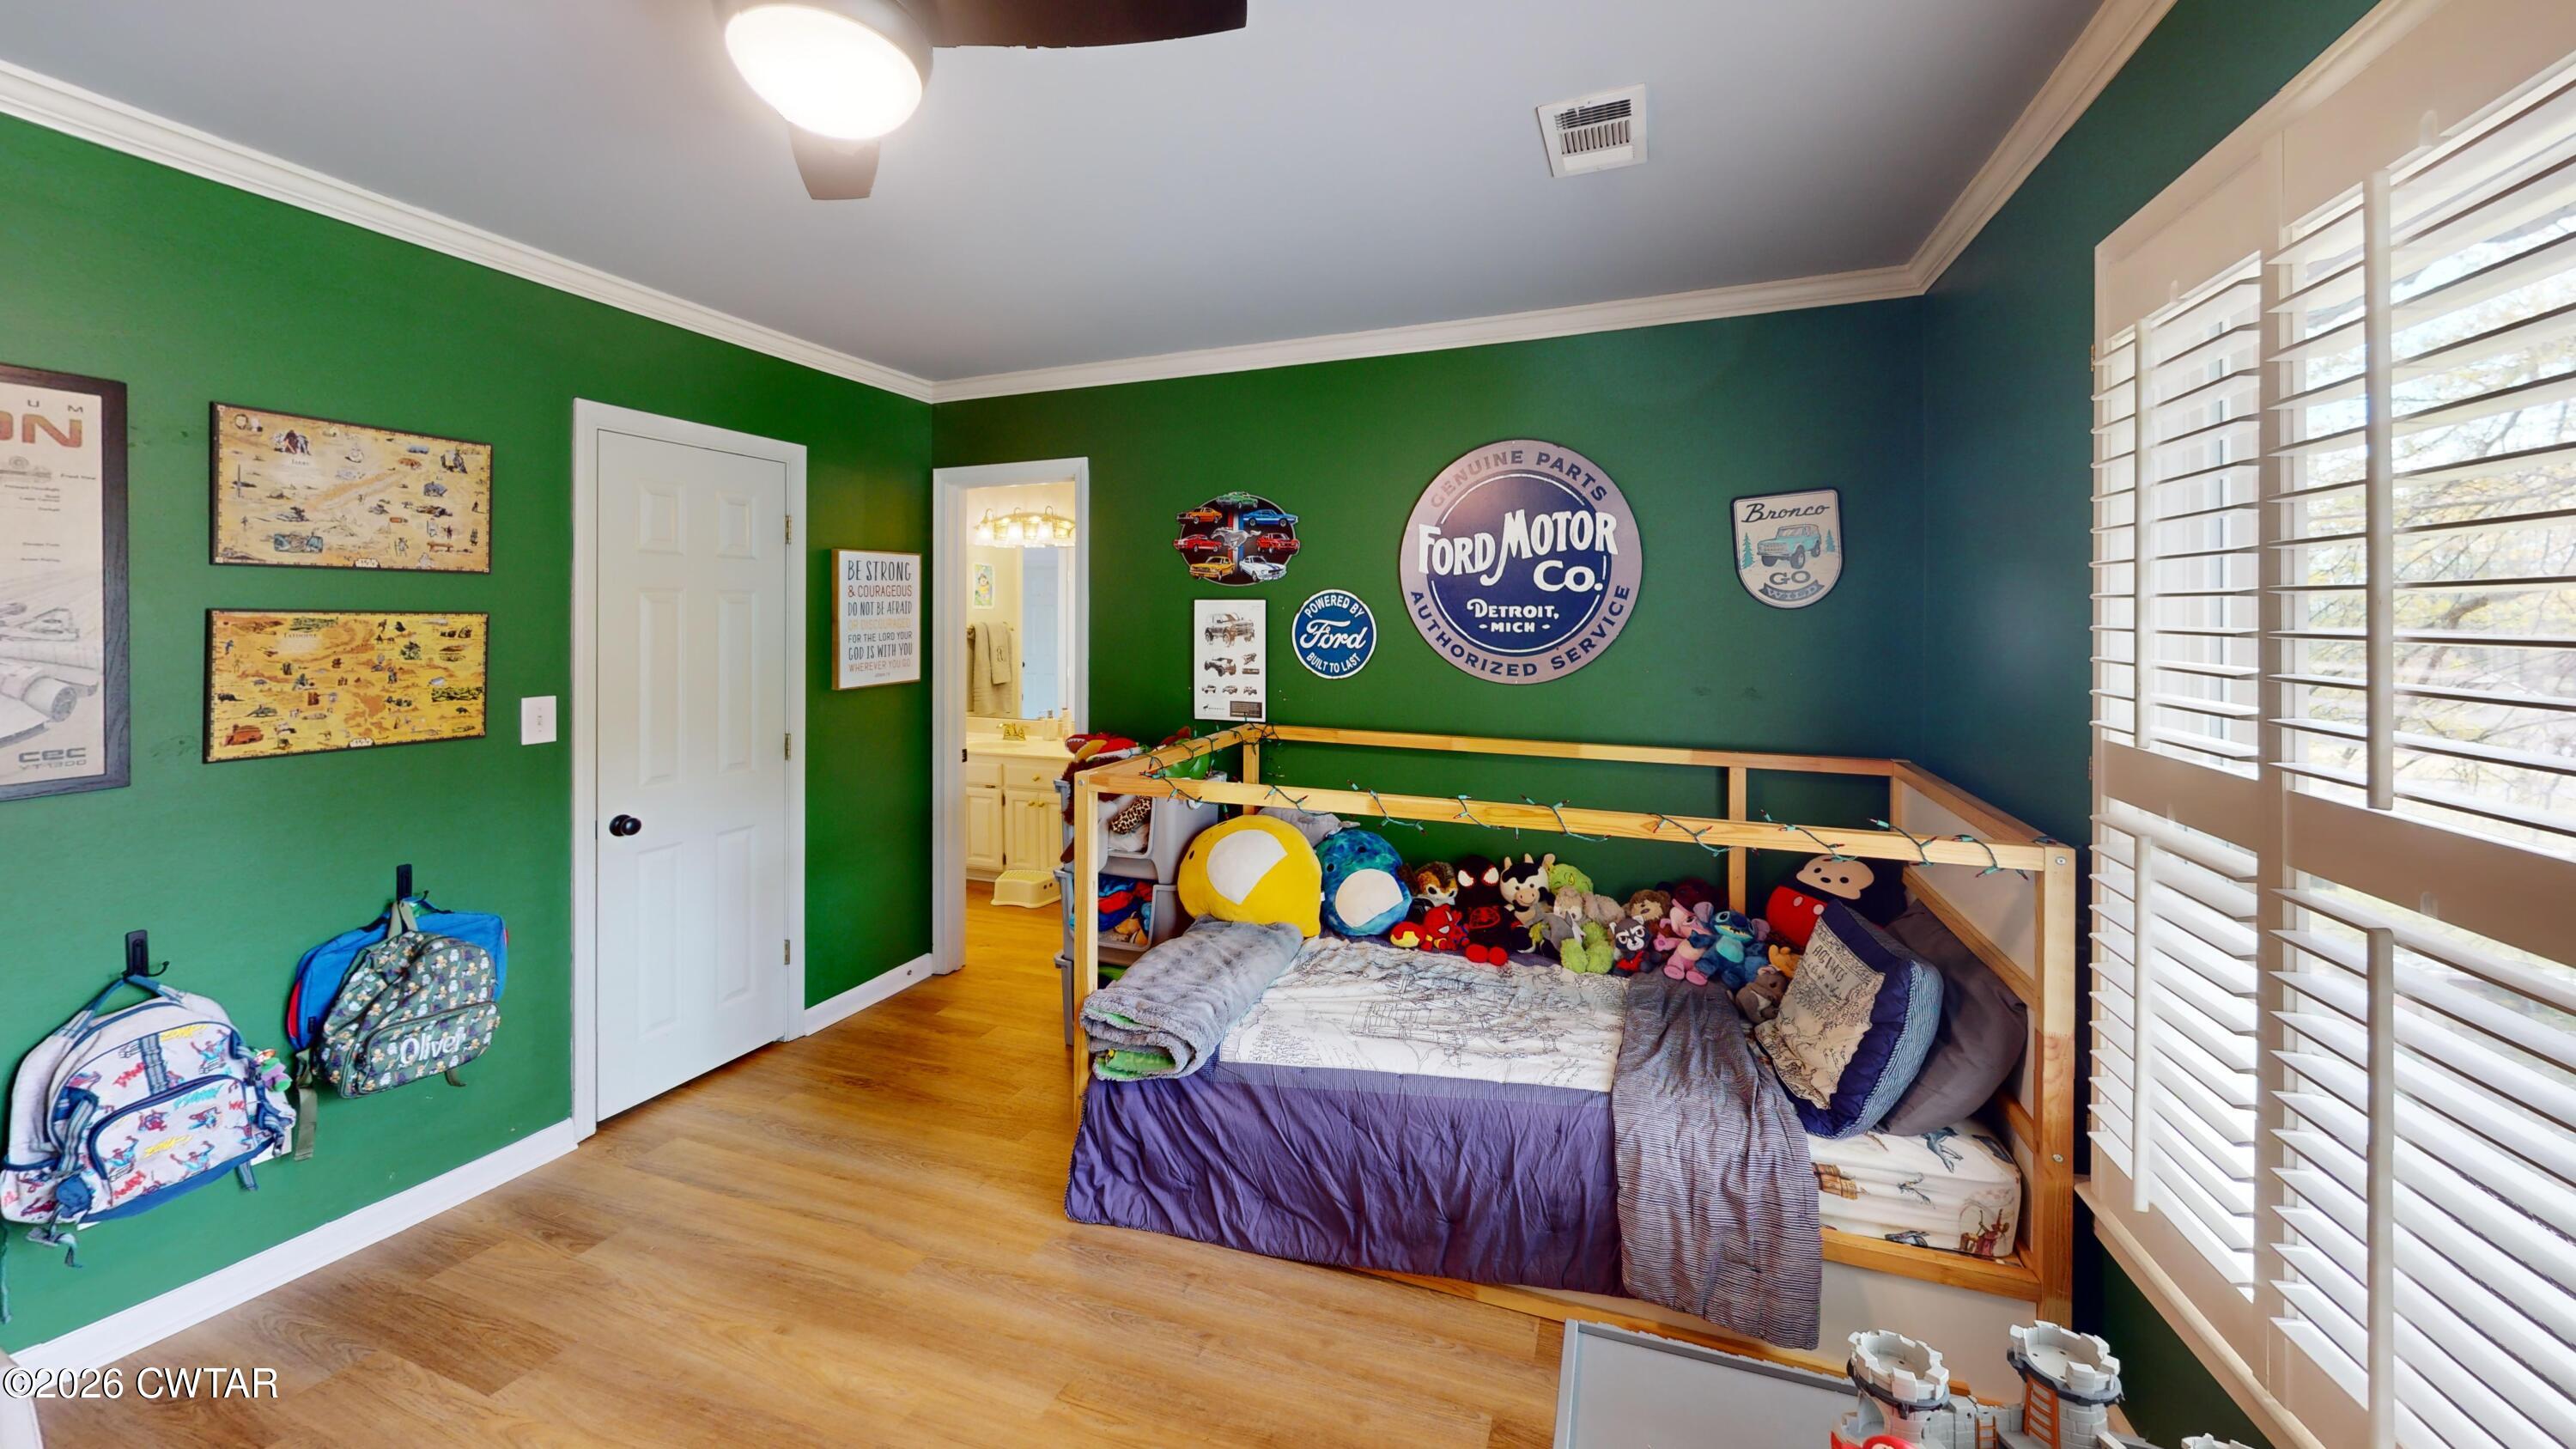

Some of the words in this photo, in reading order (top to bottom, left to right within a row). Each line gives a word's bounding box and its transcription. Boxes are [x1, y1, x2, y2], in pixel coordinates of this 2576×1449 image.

[0, 411, 82, 448] N
[1431, 450, 1523, 508] GENUINE
[1535, 452, 1607, 502] PARTS
[1741, 503, 1831, 522] Bronco
[1419, 524, 1496, 575] FORD
[1480, 508, 1618, 586] MOTOR
[848, 560, 862, 581] BE
[866, 560, 911, 581] STRONG
[1769, 570, 1811, 584] GO
[848, 586, 855, 598] &
[858, 584, 912, 598] COURAGEOUS
[1766, 585, 1817, 600] WILD
[848, 601, 858, 616] DO
[860, 601, 874, 616] NOT
[877, 601, 884, 615] BE
[887, 600, 912, 615] AFRAID
[1303, 594, 1350, 618] POWERED
[1350, 603, 1365, 618] BY
[848, 634, 861, 643] FOR
[864, 634, 876, 642] THE
[879, 632, 895, 641] LORD
[896, 631, 913, 640] YOUR
[1300, 619, 1368, 648] Ford
[1411, 591, 1537, 677] AUTHORIZED
[1551, 585, 1630, 670] SERVICE
[1491, 622, 1535, 633] MICH
[848, 647, 864, 660] GOD
[867, 646, 874, 659] IS
[878, 644, 896, 658] WITH
[899, 642, 913, 655] YOU
[848, 660, 887, 672] WHEREVER
[889, 660, 901, 668] YOU
[1307, 652, 1328, 672] BUILT
[1329, 663, 1340, 673] TO
[1341, 653, 1360, 672] LAST
[400, 1030, 467, 1065] Oliver
